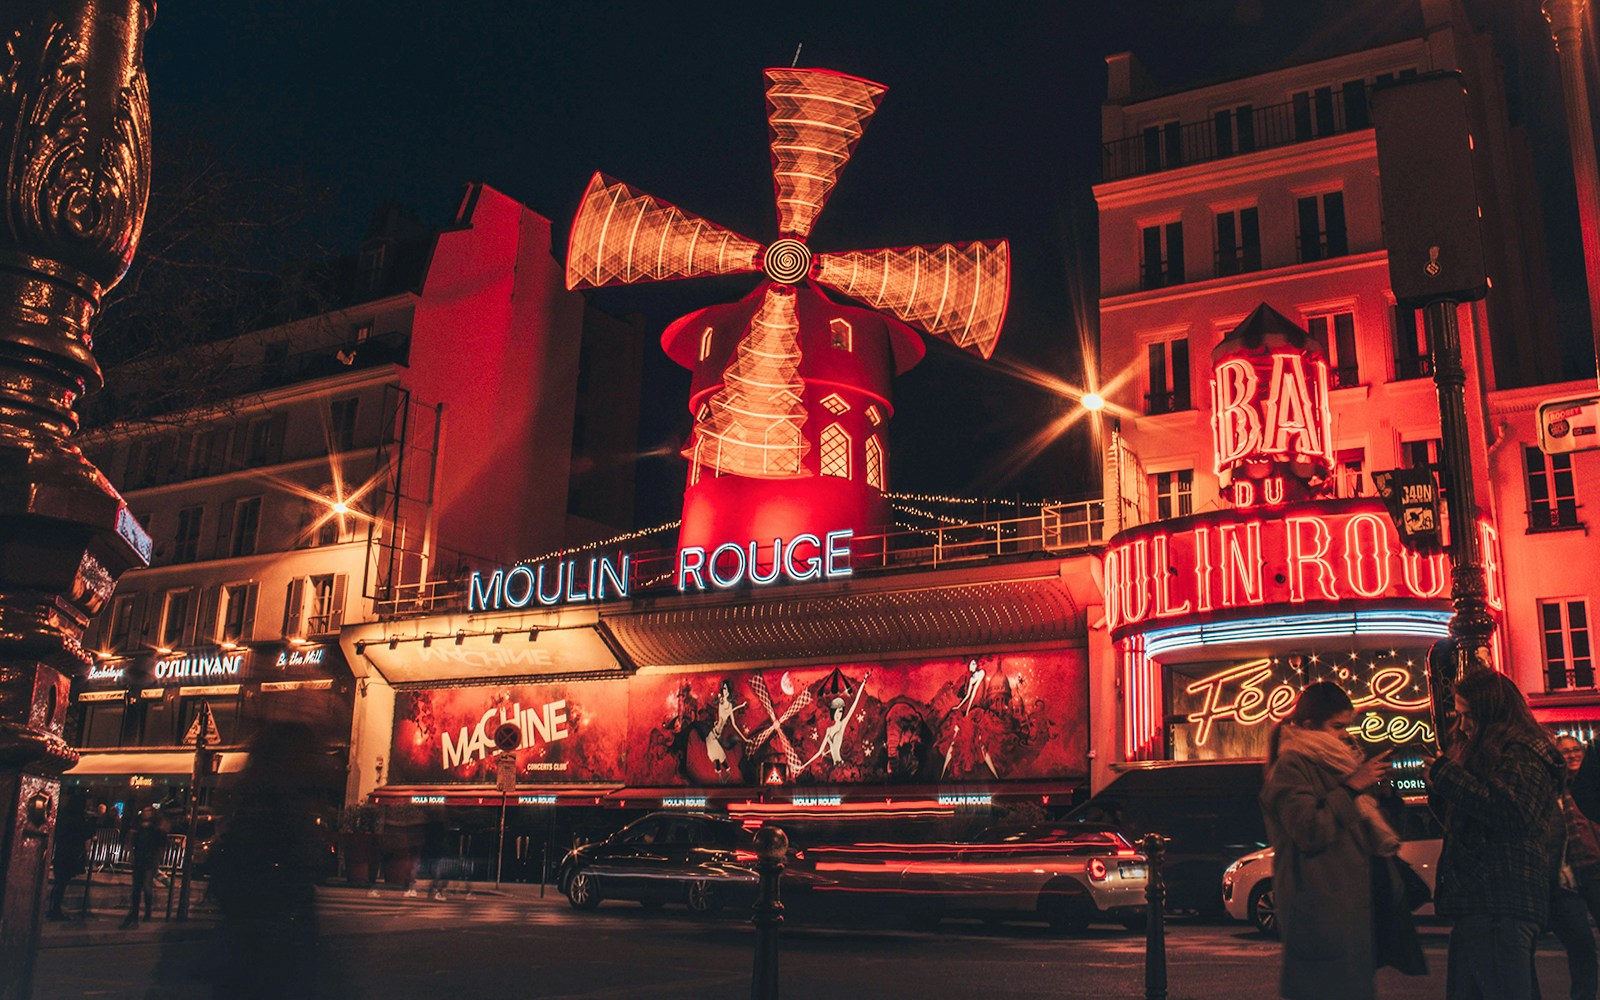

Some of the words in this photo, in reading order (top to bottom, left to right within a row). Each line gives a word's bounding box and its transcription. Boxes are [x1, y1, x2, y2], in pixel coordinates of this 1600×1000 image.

[1235, 478, 1283, 508] DU
[467, 554, 630, 611] MOULIN
[678, 528, 855, 591] ROUGE
[1104, 521, 1263, 632] OULIN
[1285, 513, 1502, 610] ROUE
[154, 655, 242, 679] O'SULLIVANS
[441, 699, 569, 770] MACHINE
[527, 762, 553, 771] CONCERTS
[662, 798, 685, 807] MOULIN
[685, 797, 706, 806] ROUGE
[793, 797, 817, 806] MOULIN
[817, 797, 841, 806] ROUGE
[938, 796, 965, 805] MOULIN
[966, 795, 992, 805] ROUGE
